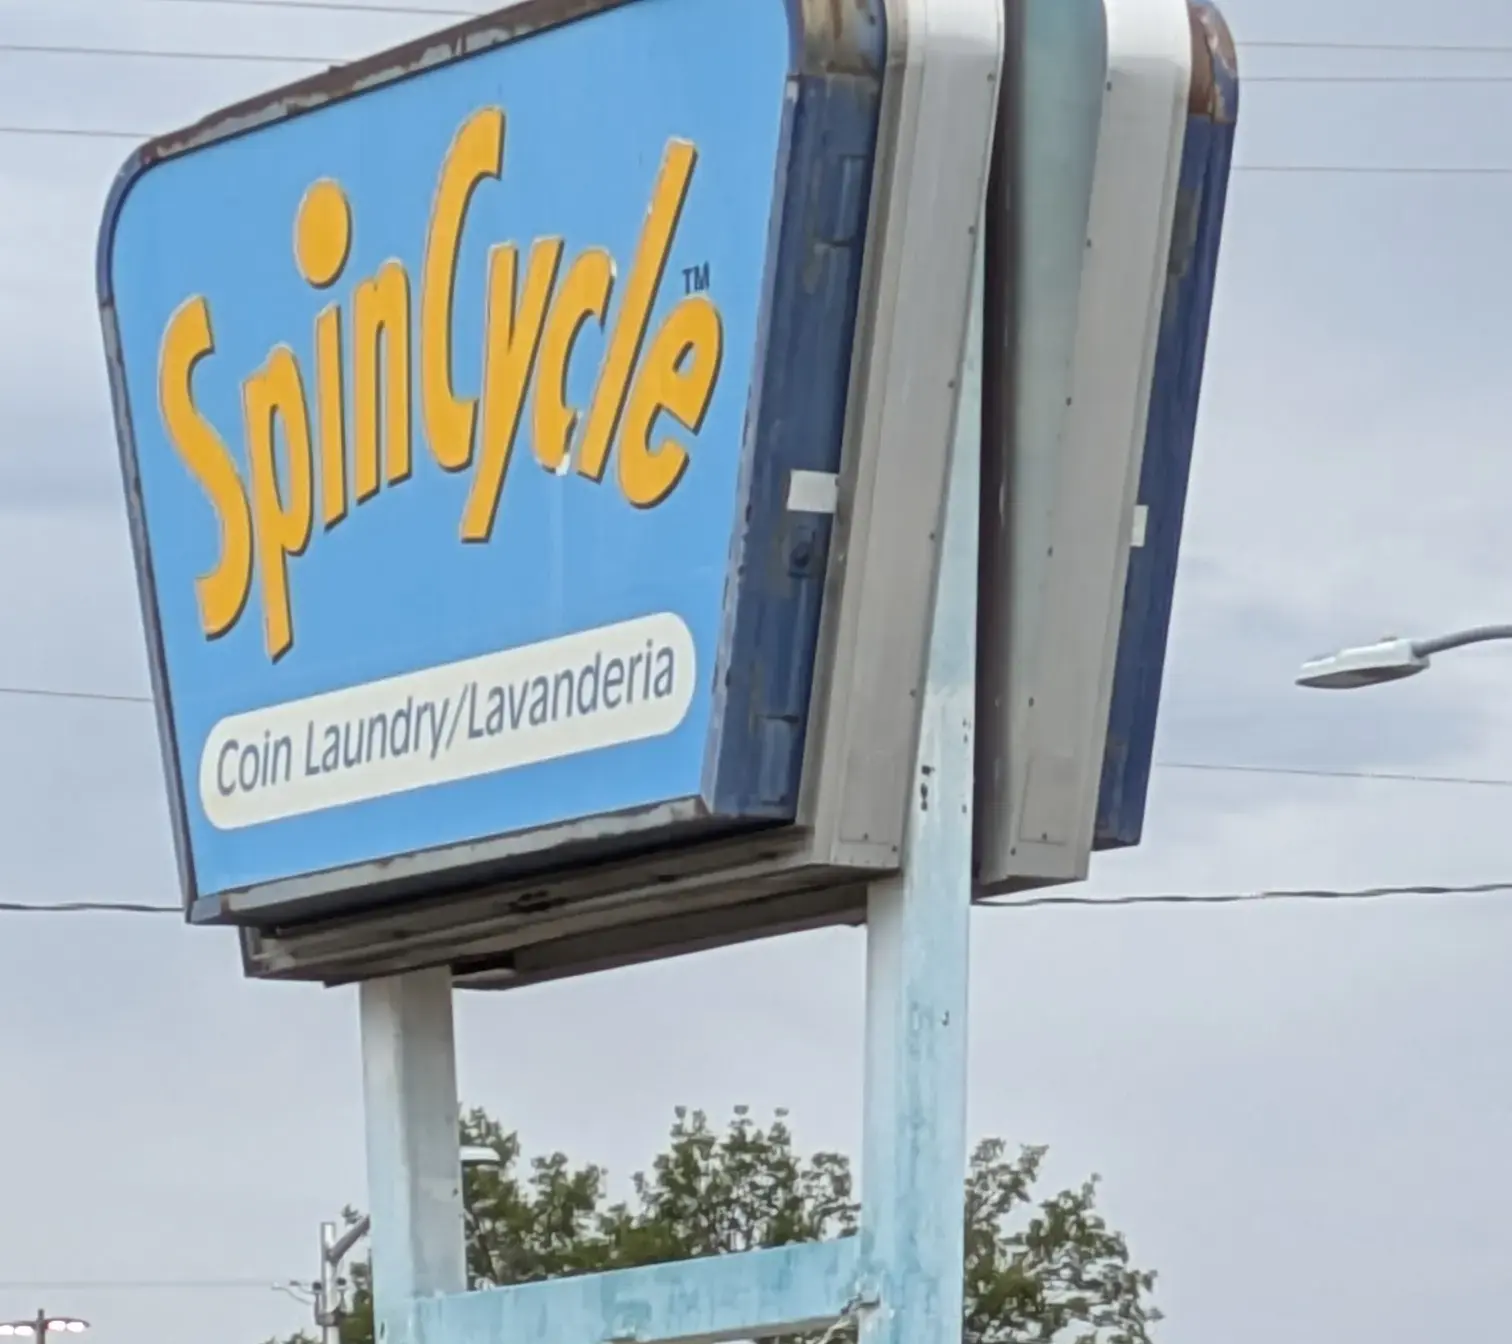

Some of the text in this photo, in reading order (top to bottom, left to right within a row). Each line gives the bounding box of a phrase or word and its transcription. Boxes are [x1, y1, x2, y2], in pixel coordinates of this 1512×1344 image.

[158, 106, 723, 664] SpinCycle
[215, 640, 676, 798] Coin Laundry/Lavanderia
